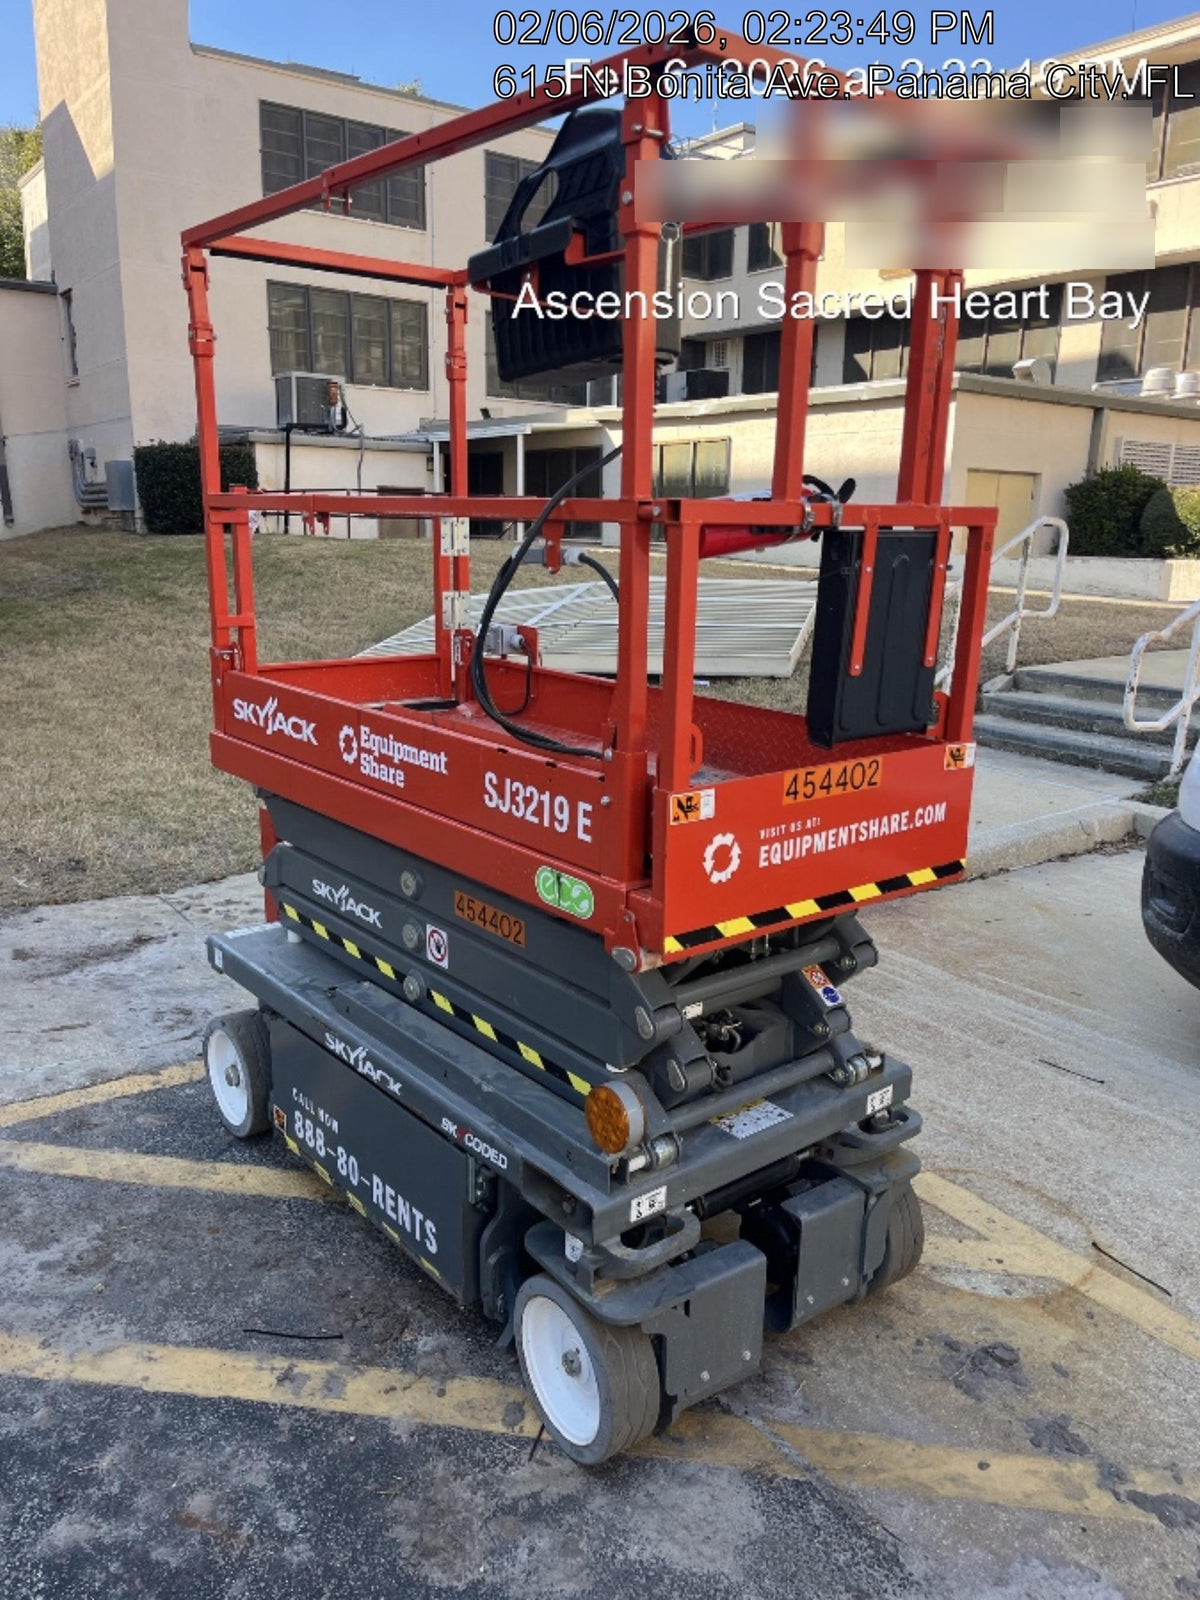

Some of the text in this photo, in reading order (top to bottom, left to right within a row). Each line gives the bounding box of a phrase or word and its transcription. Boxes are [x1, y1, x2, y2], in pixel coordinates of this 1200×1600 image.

[232, 696, 319, 746] SKYJACK
[360, 725, 449, 776] Equipment
[360, 753, 405, 788] Share
[785, 759, 880, 801] 454402
[484, 771, 593, 843] SJ3219 E
[760, 824, 787, 840] VISIT
[790, 821, 803, 833] US
[759, 801, 947, 868] EQUIPMENTSHARE.COM
[312, 879, 383, 929] SKYJACK
[456, 894, 523, 945] 454402
[325, 1032, 403, 1096] SKYJACK
[292, 1087, 339, 1134] CALL NOW
[294, 1110, 438, 1254] 888-80-RENTS
